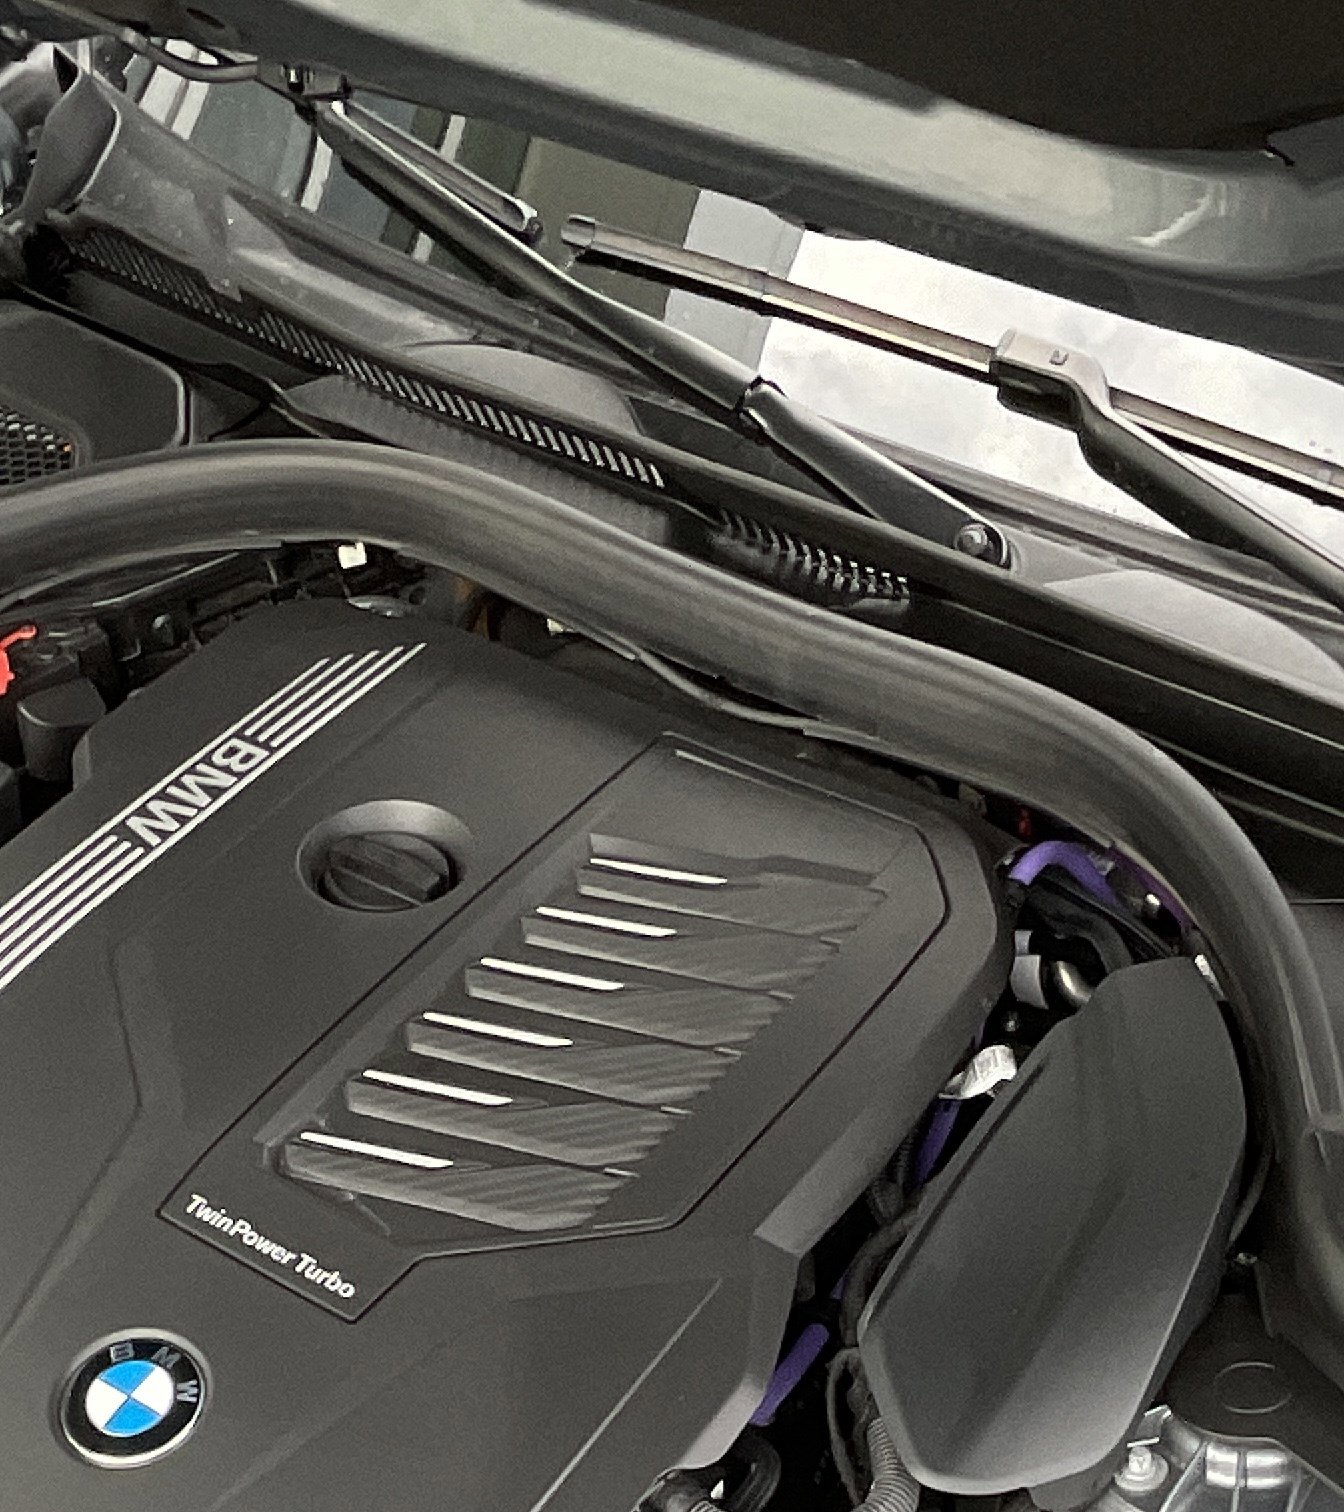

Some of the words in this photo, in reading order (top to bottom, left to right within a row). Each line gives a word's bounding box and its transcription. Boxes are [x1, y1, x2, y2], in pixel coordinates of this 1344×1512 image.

[126, 738, 270, 847] BMW
[186, 1193, 298, 1264] TwinPower
[294, 1253, 356, 1298] Turbo
